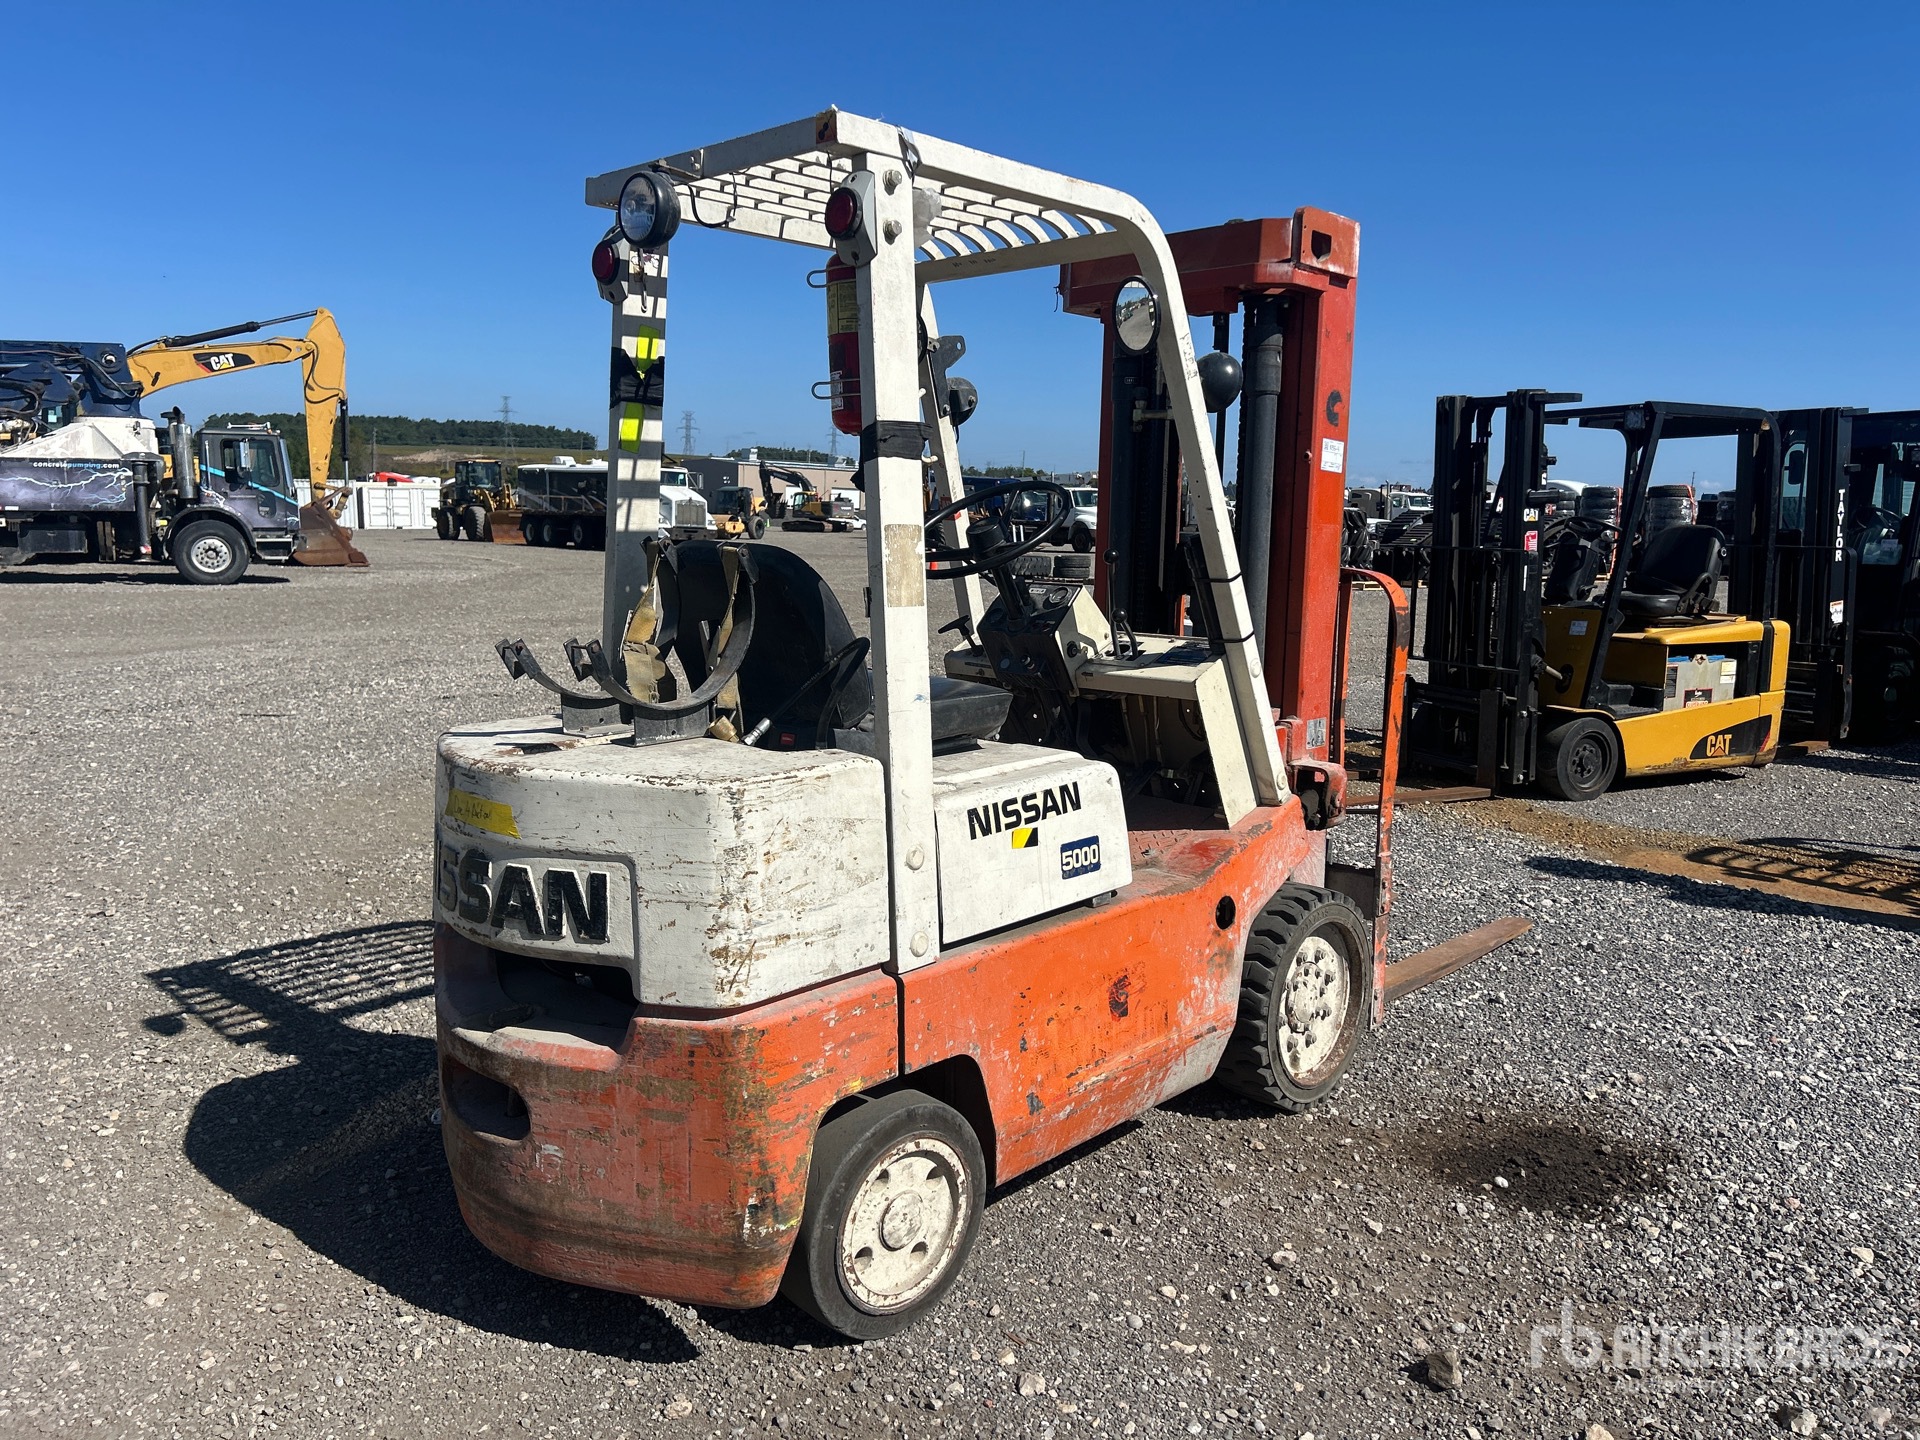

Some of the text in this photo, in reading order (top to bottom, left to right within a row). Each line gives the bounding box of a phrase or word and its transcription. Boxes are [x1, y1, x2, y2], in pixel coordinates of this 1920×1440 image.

[210, 353, 235, 371] CAT
[32, 461, 120, 469] concretepumping.com
[1523, 508, 1539, 521] CAT
[1834, 489, 1846, 562] TAYLOR
[1706, 734, 1733, 757] CAT
[966, 781, 1082, 841] NISSAN
[1061, 844, 1099, 871] 5000
